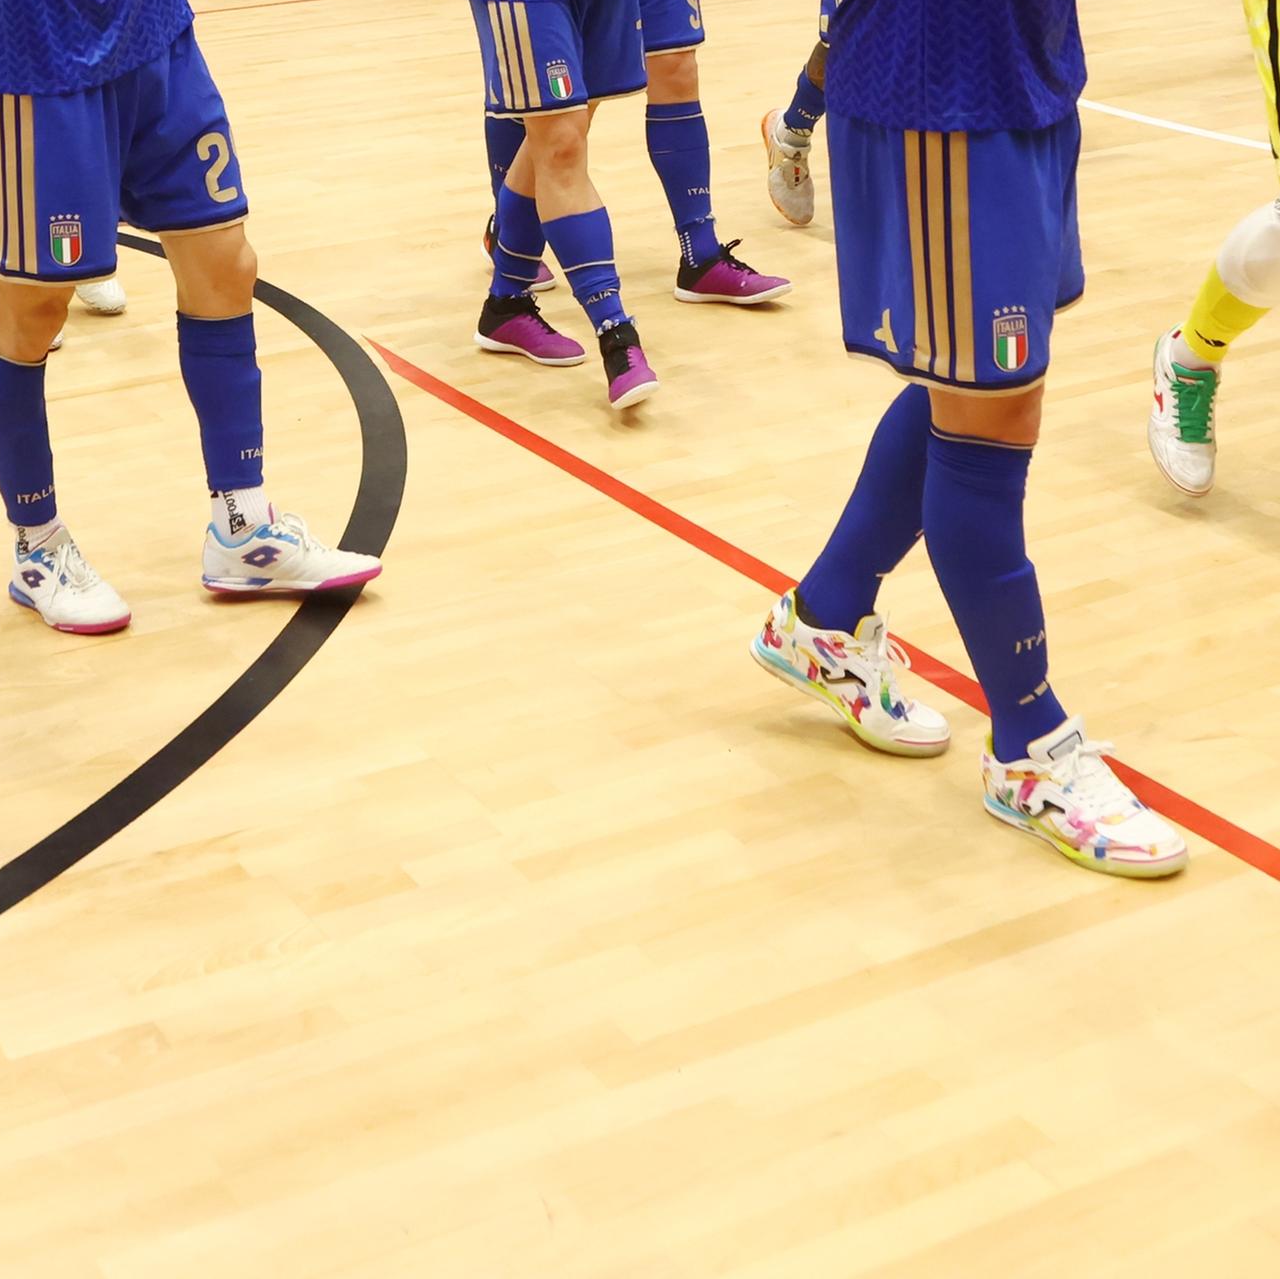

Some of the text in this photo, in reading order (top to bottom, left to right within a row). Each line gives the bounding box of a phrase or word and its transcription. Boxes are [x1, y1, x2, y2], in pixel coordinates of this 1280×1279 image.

[196, 132, 238, 203] 2
[52, 224, 78, 235] ITALIA
[996, 320, 1024, 333] ITALIA
